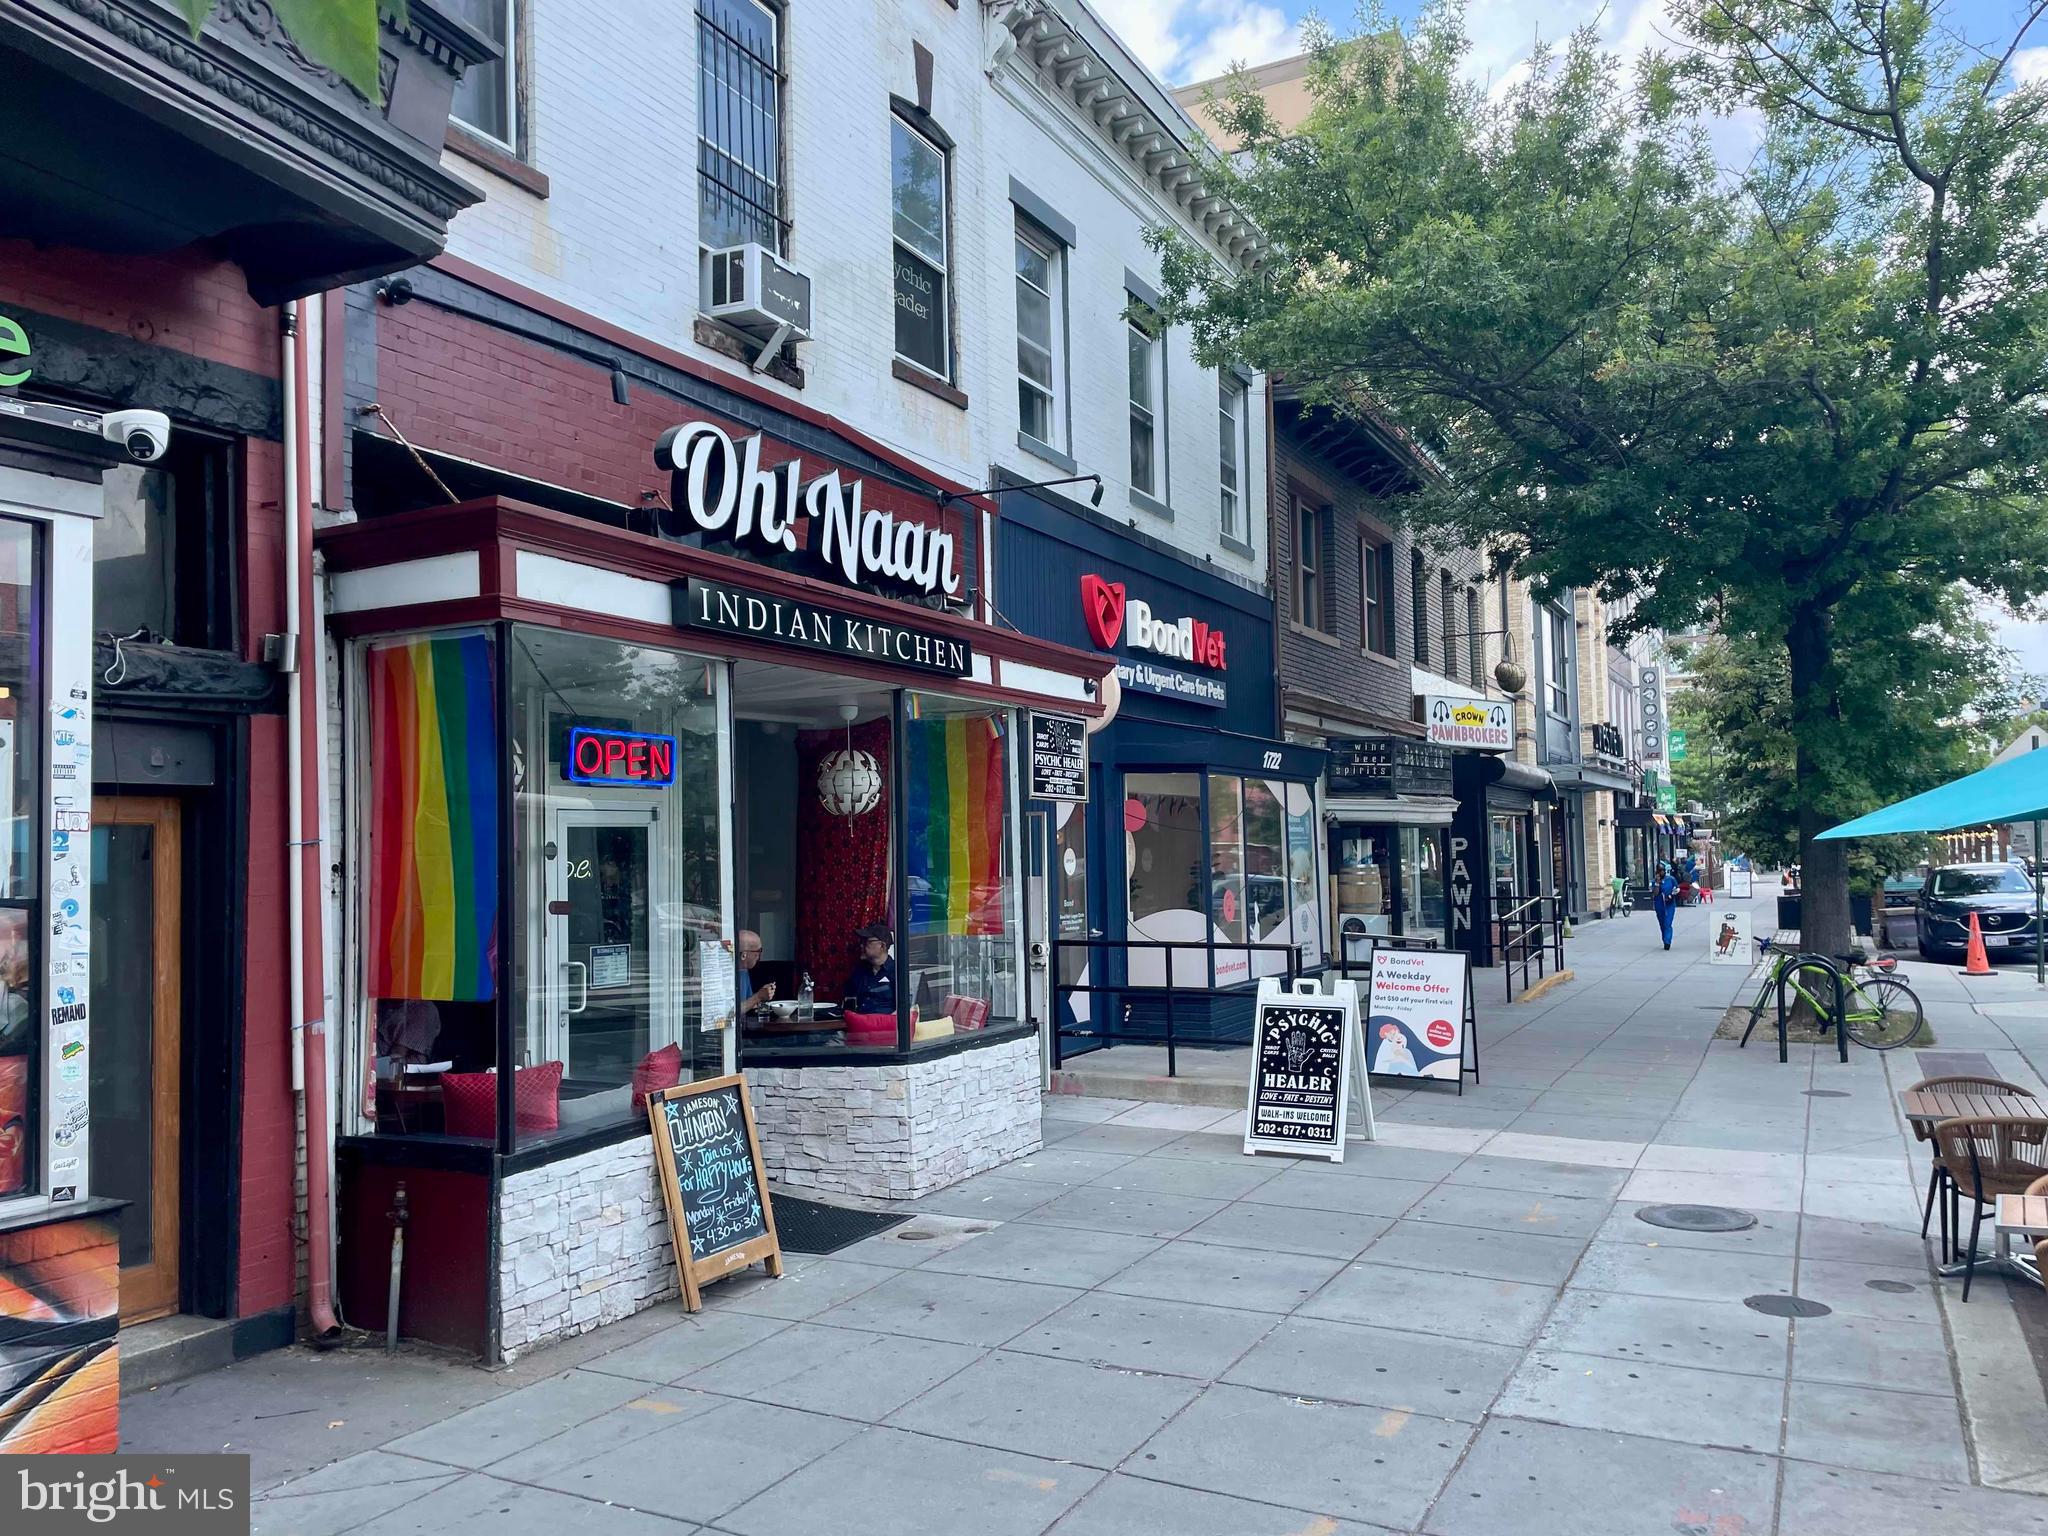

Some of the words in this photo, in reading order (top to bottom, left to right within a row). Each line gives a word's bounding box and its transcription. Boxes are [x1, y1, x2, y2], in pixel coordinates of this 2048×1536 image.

[671, 421, 801, 552] Oh!
[805, 467, 960, 594] Naan
[700, 587, 832, 645] INDIAN
[846, 619, 964, 671] KITCHEN
[1144, 666, 1175, 692] Urgent
[1175, 674, 1195, 694] Care
[1195, 678, 1207, 697] for
[1207, 681, 1225, 700] Pets
[1455, 711, 1484, 724] CROWN
[1431, 724, 1508, 744] PAWNBROKERS
[1354, 742, 1386, 751] wine
[576, 737, 670, 776] OPEN
[1034, 753, 1062, 767] PSYCHIC
[1063, 757, 1084, 770] HEALER
[1263, 751, 1282, 769] 1722
[1354, 754, 1386, 763] beer
[1335, 766, 1386, 776] spirits
[1451, 837, 1472, 930] PAWN
[1376, 970, 1384, 978] A
[1387, 970, 1431, 983] Weekday
[1376, 981, 1421, 992] Welcome
[1423, 984, 1450, 993] Offer
[51, 1003, 87, 1025] REMAND
[1268, 1013, 1334, 1043] PSYCHIC
[1264, 1073, 1332, 1091] HEALER
[683, 1097, 720, 1117] JAMESON
[1260, 1092, 1278, 1100] LOVE
[1283, 1093, 1299, 1101] FATE
[1304, 1094, 1334, 1104] DESTINY
[1261, 1108, 1294, 1119] WALK-INS
[1296, 1111, 1331, 1122] WELCOME
[1257, 1122, 1276, 1134] 202
[1282, 1124, 1301, 1136] 677
[1307, 1126, 1331, 1138] 0311
[697, 1147, 720, 1167] Join
[720, 1144, 733, 1157] us
[678, 1173, 695, 1193] For
[686, 1203, 716, 1232] Monday
[723, 1190, 749, 1219] Friday
